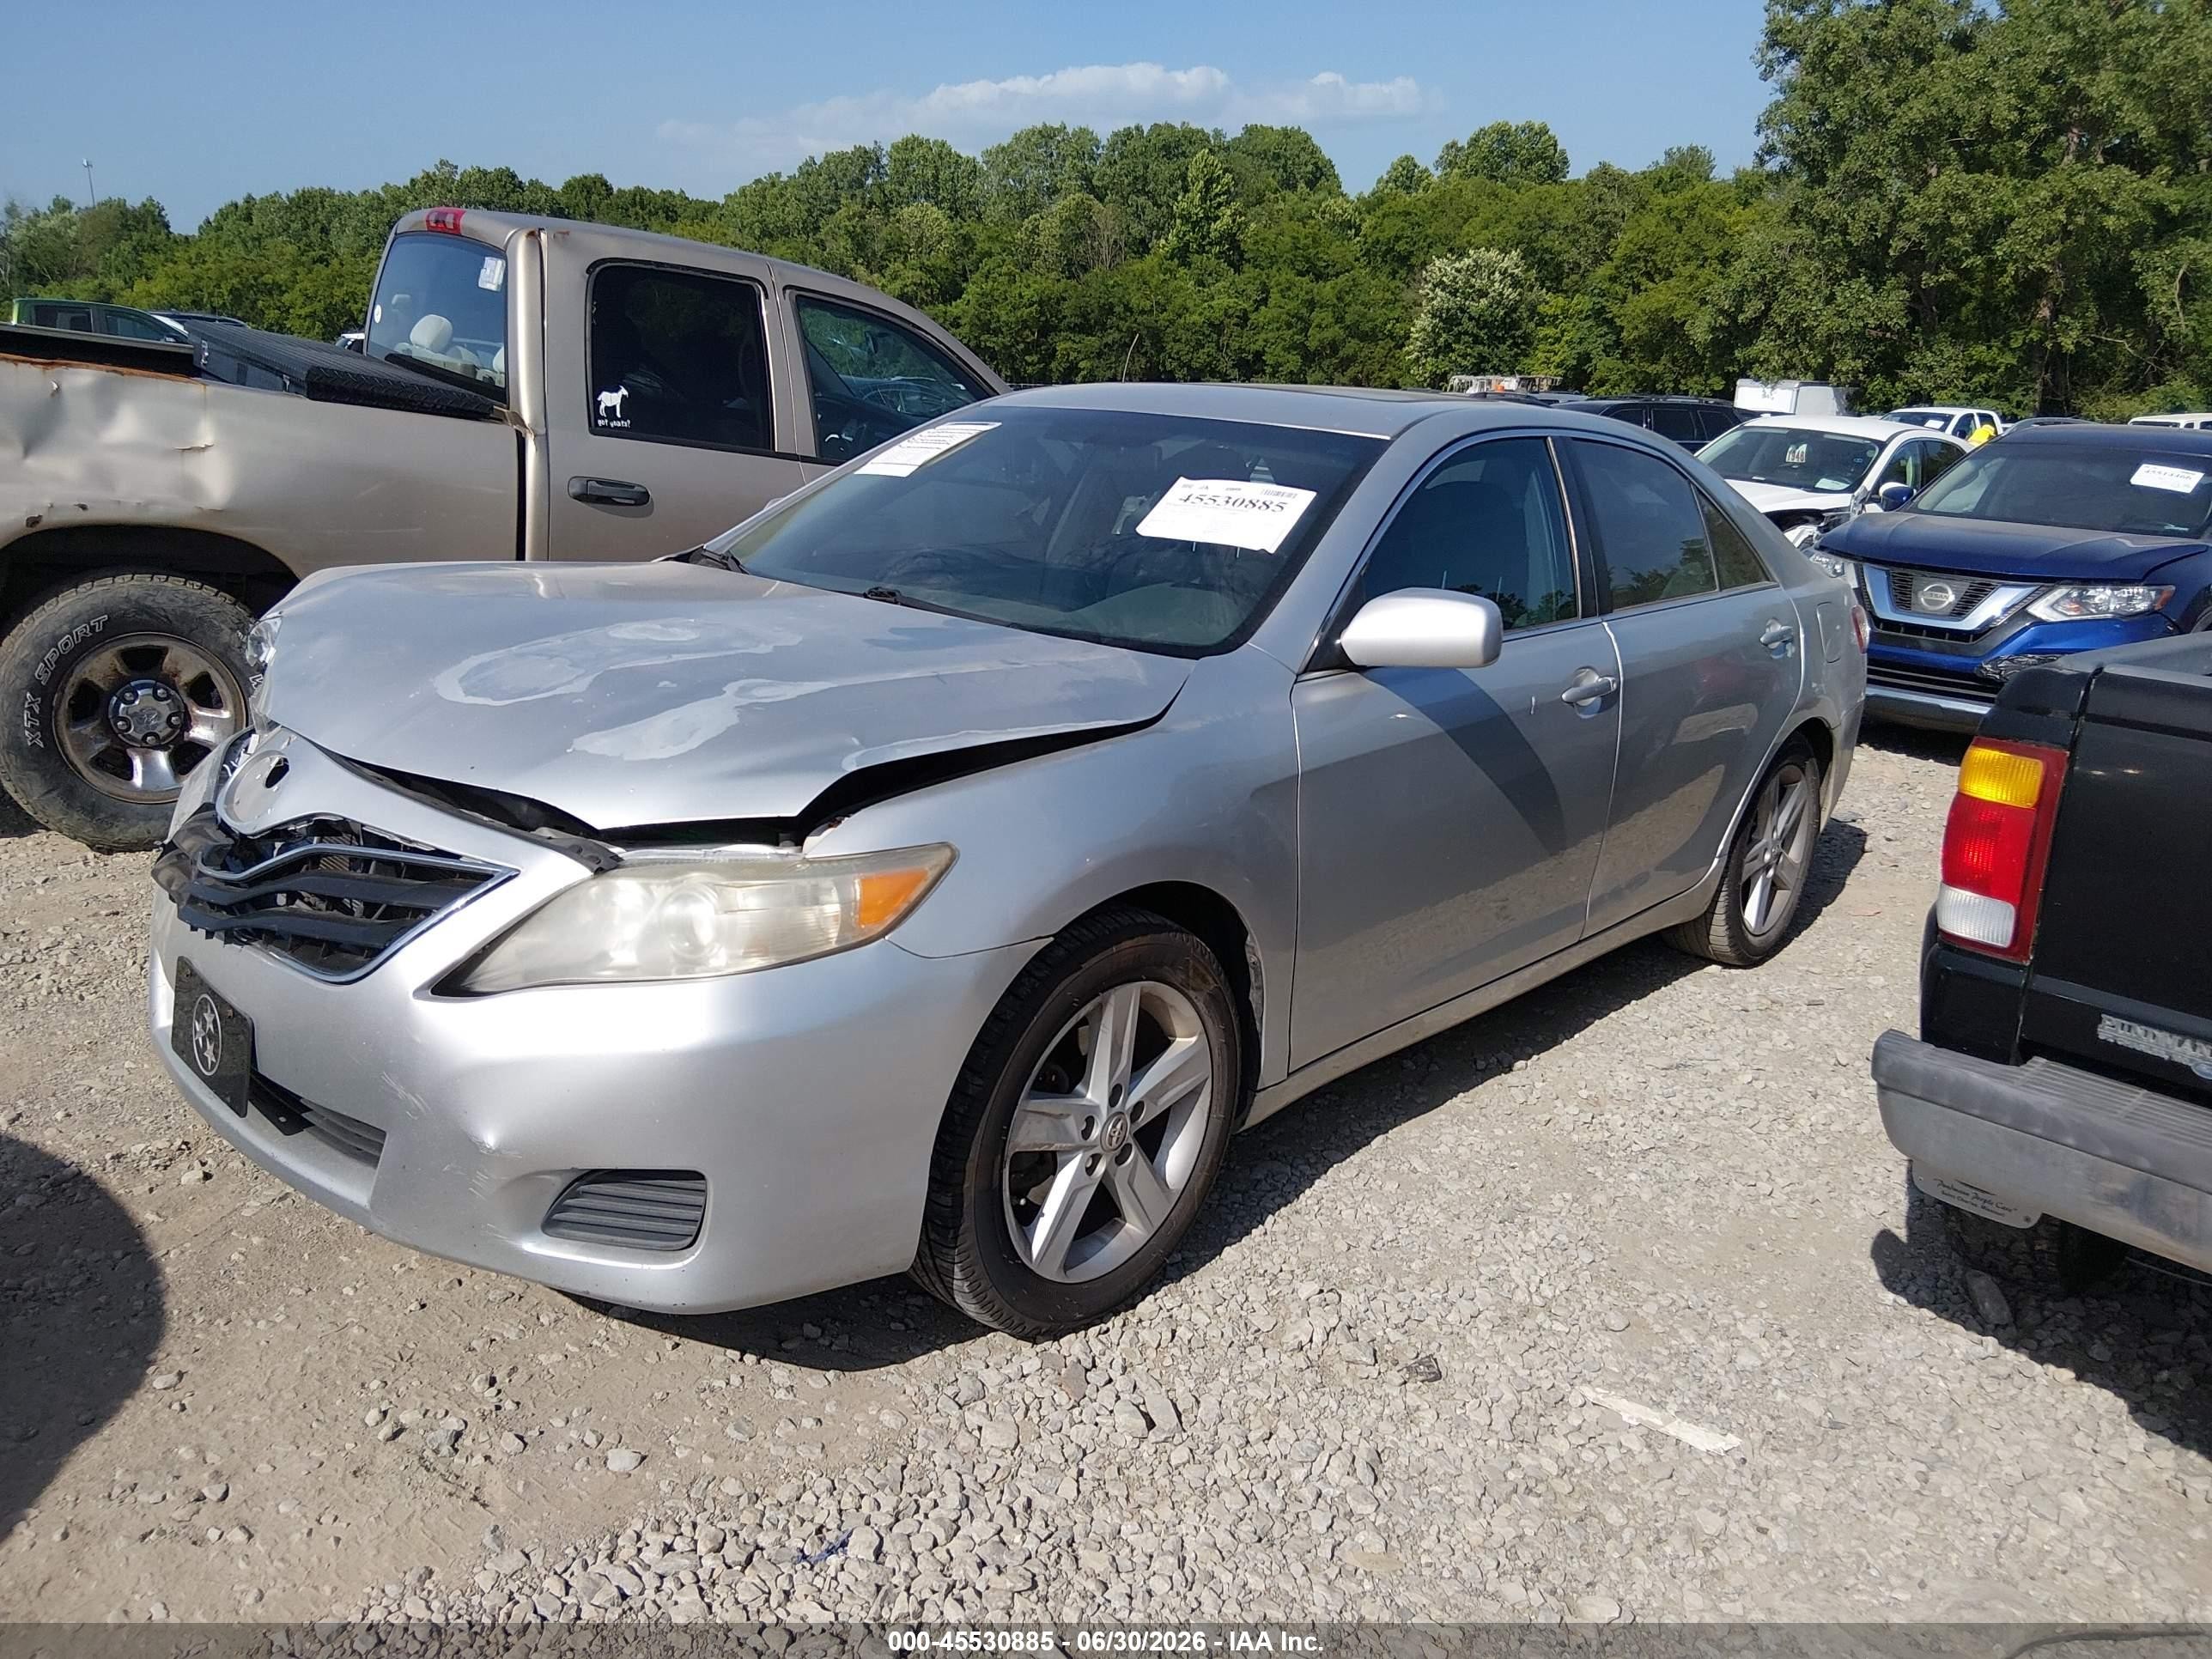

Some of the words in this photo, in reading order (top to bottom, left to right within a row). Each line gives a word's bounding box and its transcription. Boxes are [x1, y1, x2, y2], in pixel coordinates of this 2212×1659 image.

[597, 418, 609, 427] got
[610, 418, 631, 428] goats?
[1179, 493, 1290, 514] 45530885
[23, 692, 45, 748] XTX
[34, 614, 109, 685] SPORT
